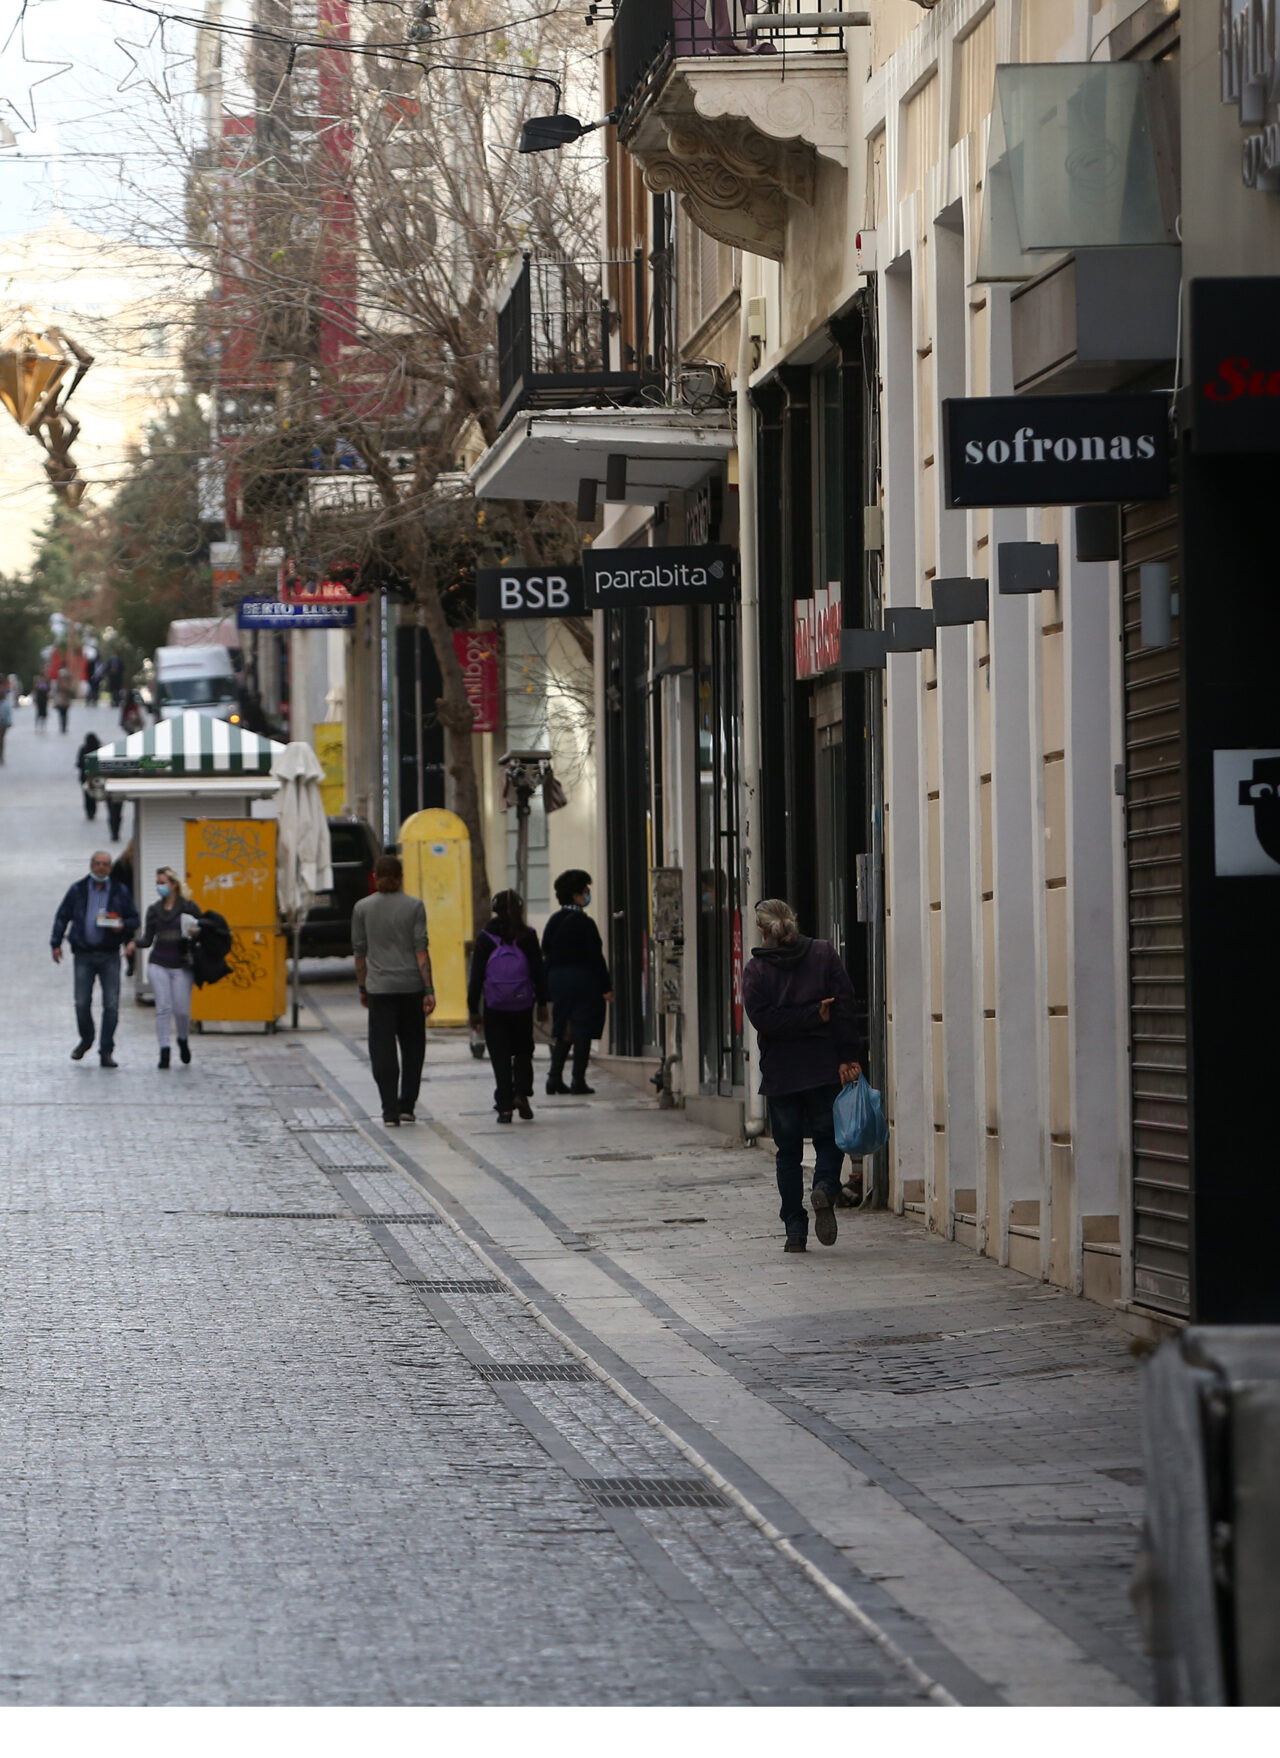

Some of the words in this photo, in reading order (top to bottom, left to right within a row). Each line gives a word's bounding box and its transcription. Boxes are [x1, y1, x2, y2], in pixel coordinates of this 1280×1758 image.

[964, 427, 1156, 465] sofronas
[500, 576, 570, 610] BSB
[595, 564, 708, 594] parabita
